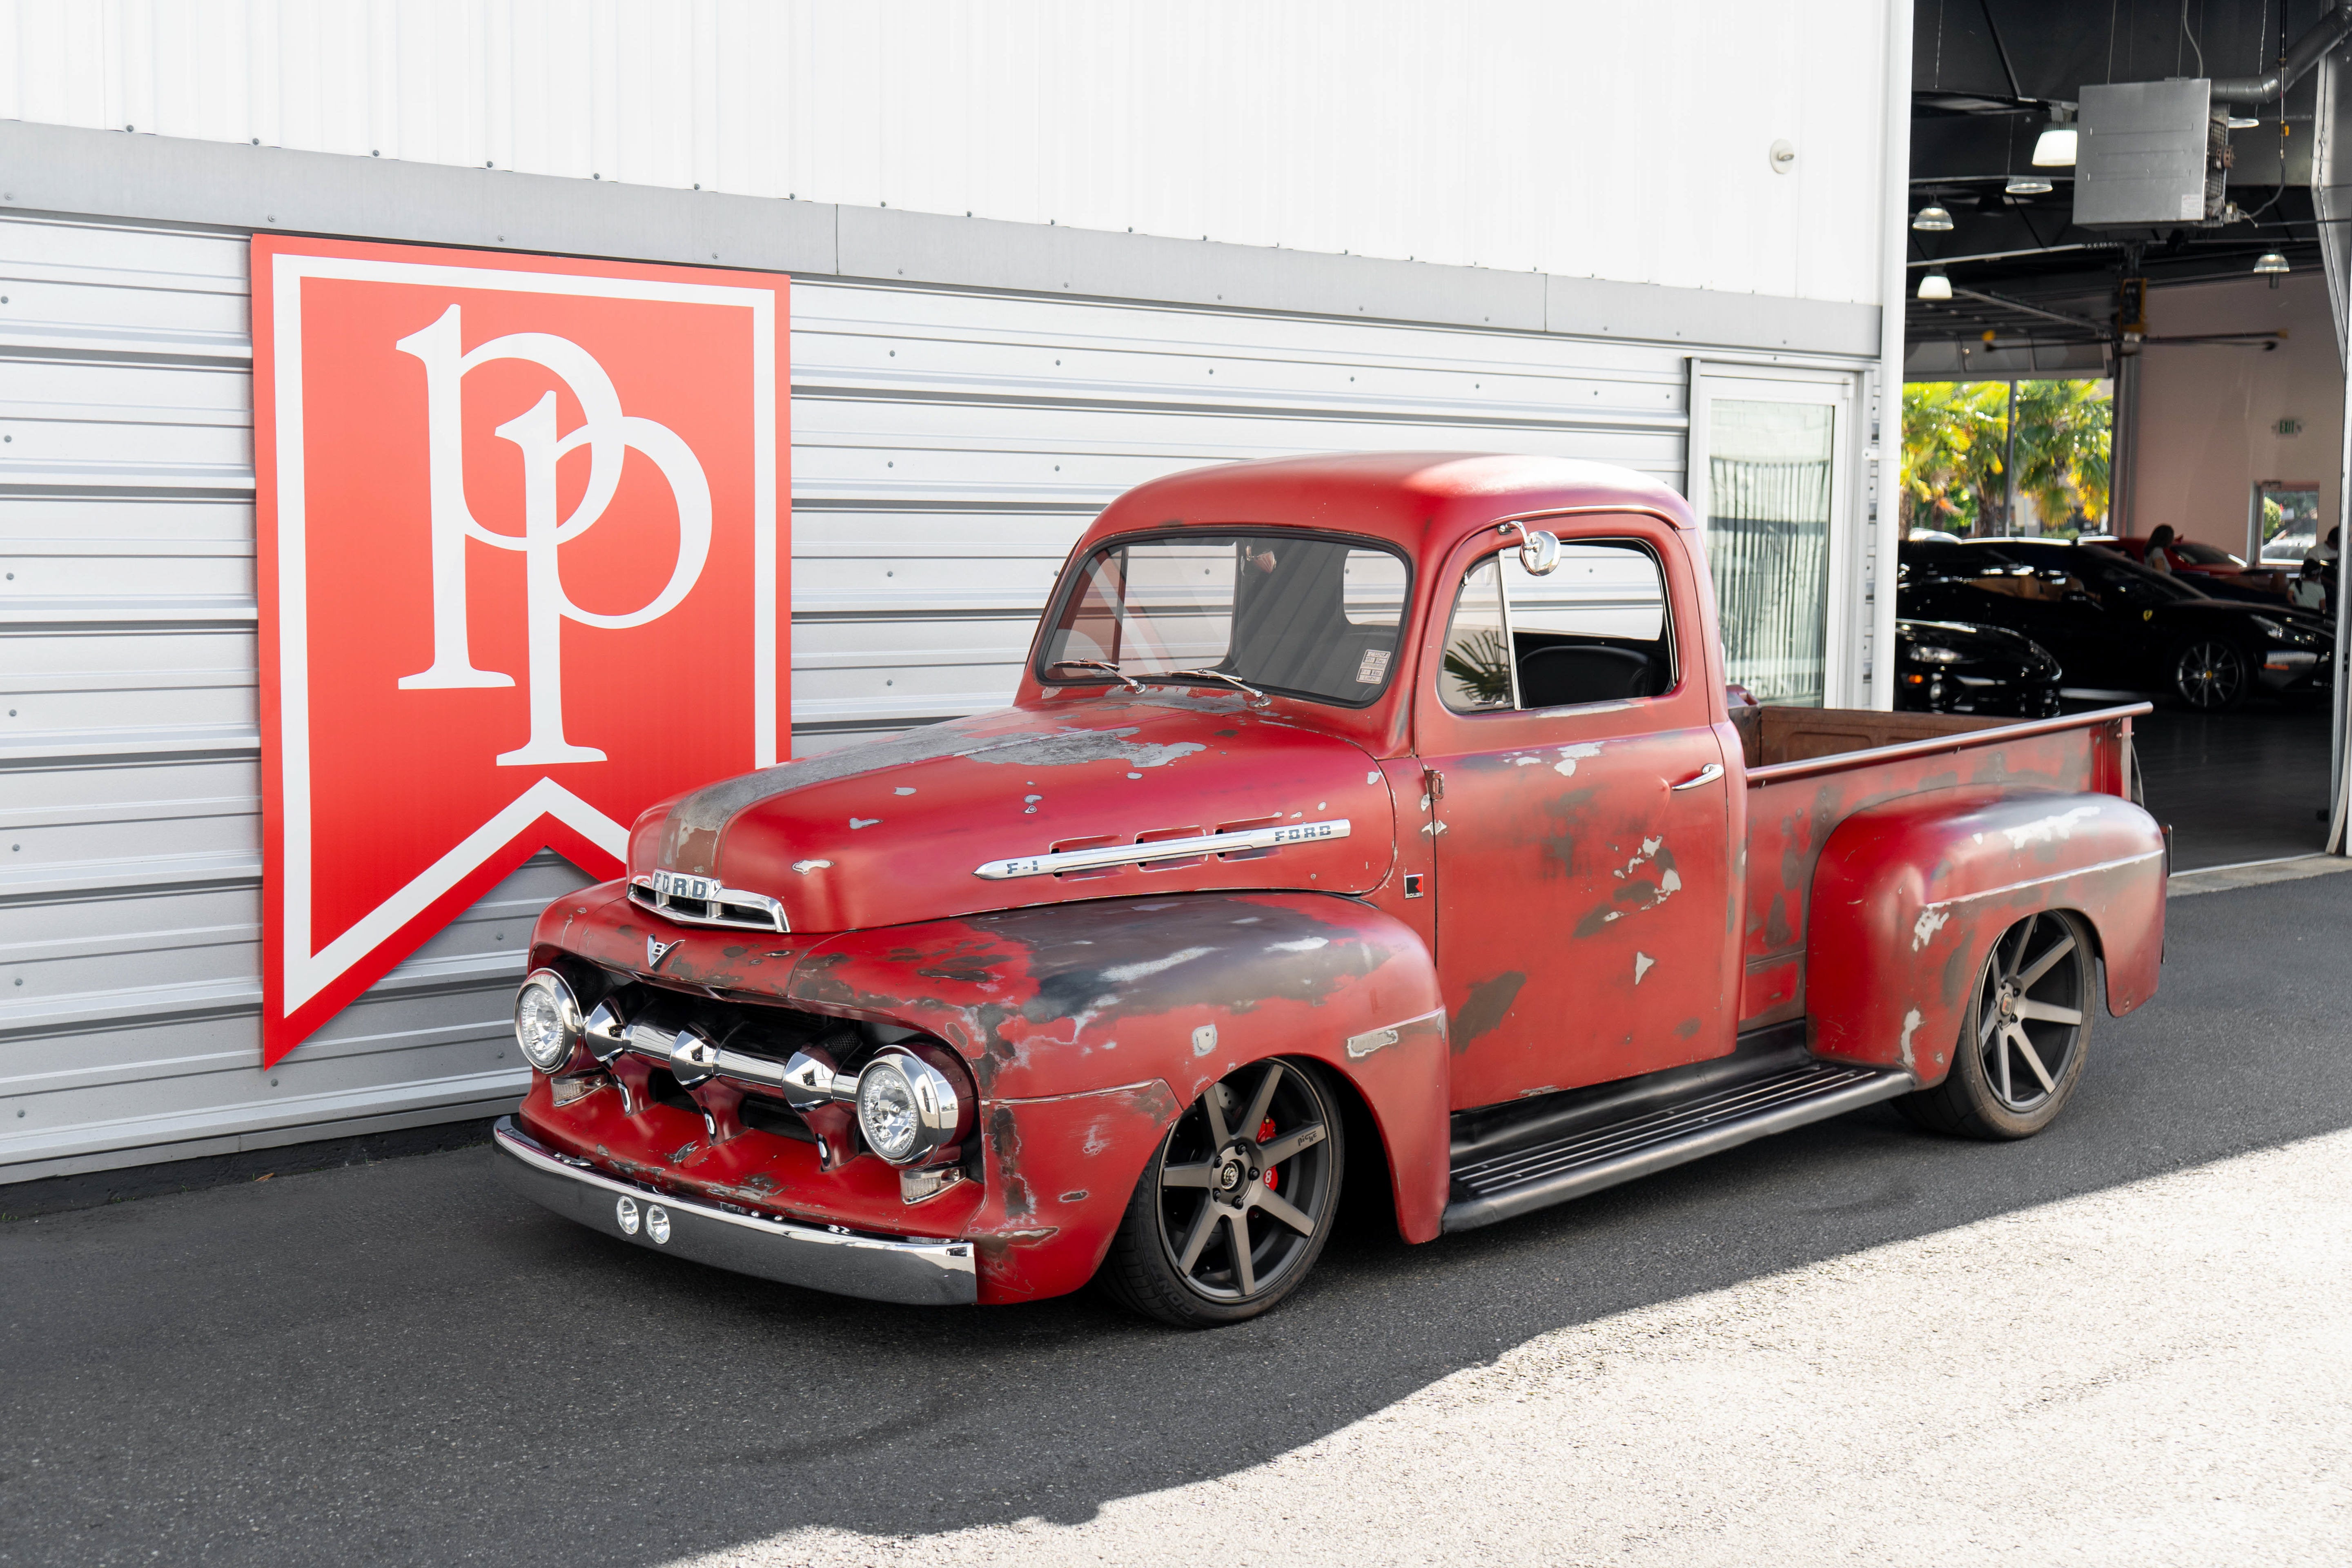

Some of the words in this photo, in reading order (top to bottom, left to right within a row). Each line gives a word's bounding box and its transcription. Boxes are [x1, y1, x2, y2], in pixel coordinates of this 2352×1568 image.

[2280, 419, 2295, 434] EXIT
[1275, 825, 1331, 842] FORD
[654, 872, 706, 899] FORD
